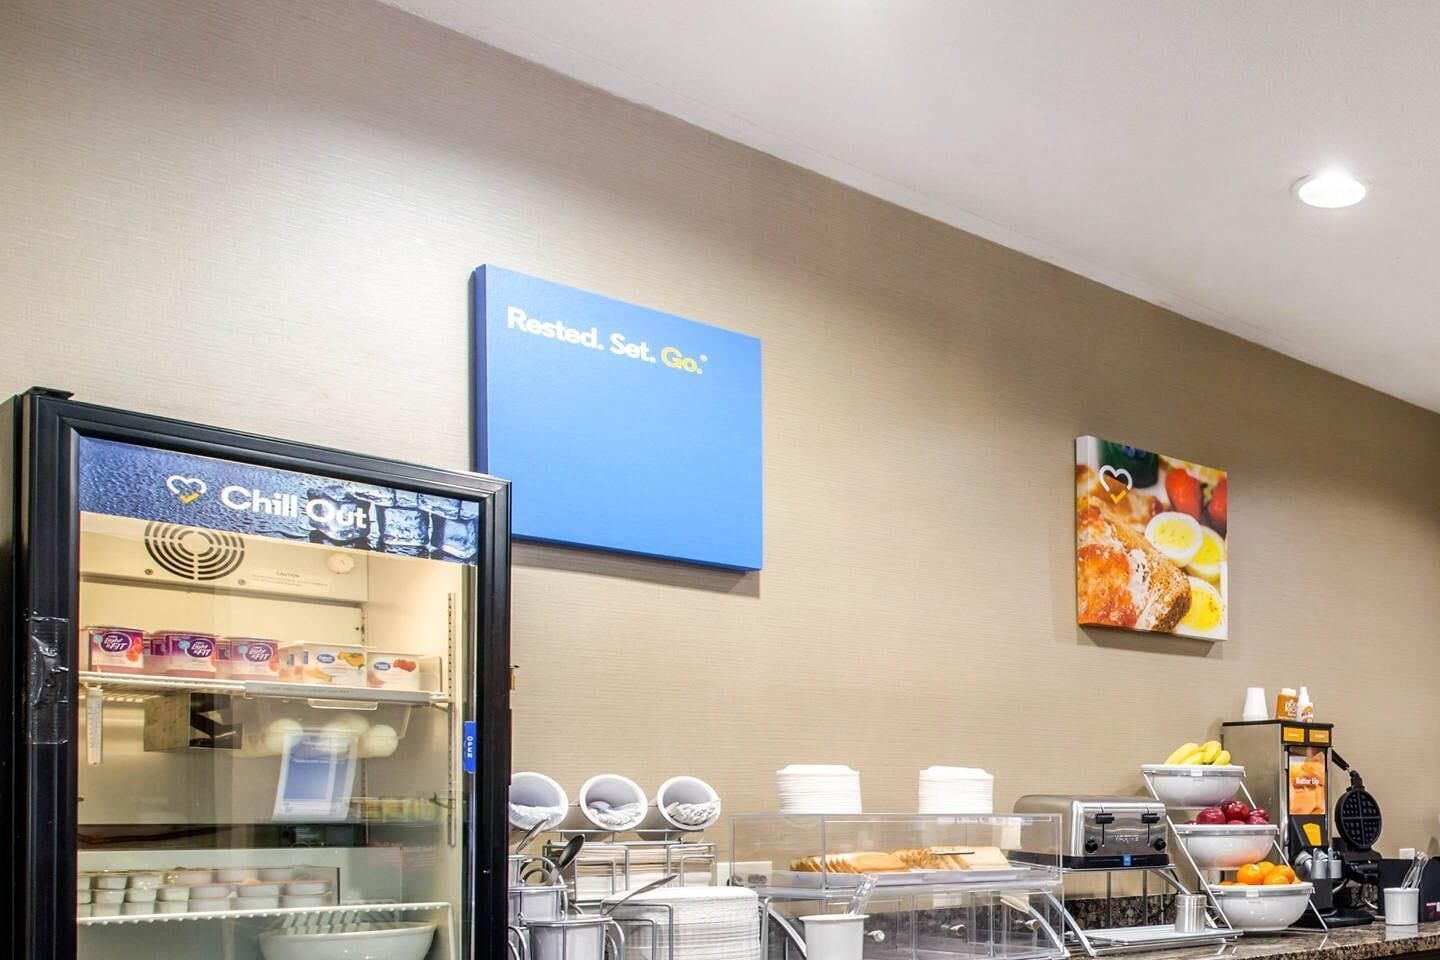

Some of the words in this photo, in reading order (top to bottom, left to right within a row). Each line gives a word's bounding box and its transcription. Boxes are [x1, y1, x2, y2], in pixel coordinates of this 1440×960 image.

[507, 305, 605, 351] Rested.
[610, 333, 656, 363] Set.
[220, 485, 298, 519] Chill
[305, 498, 367, 529] Out
[466, 735, 474, 759] OPEN
